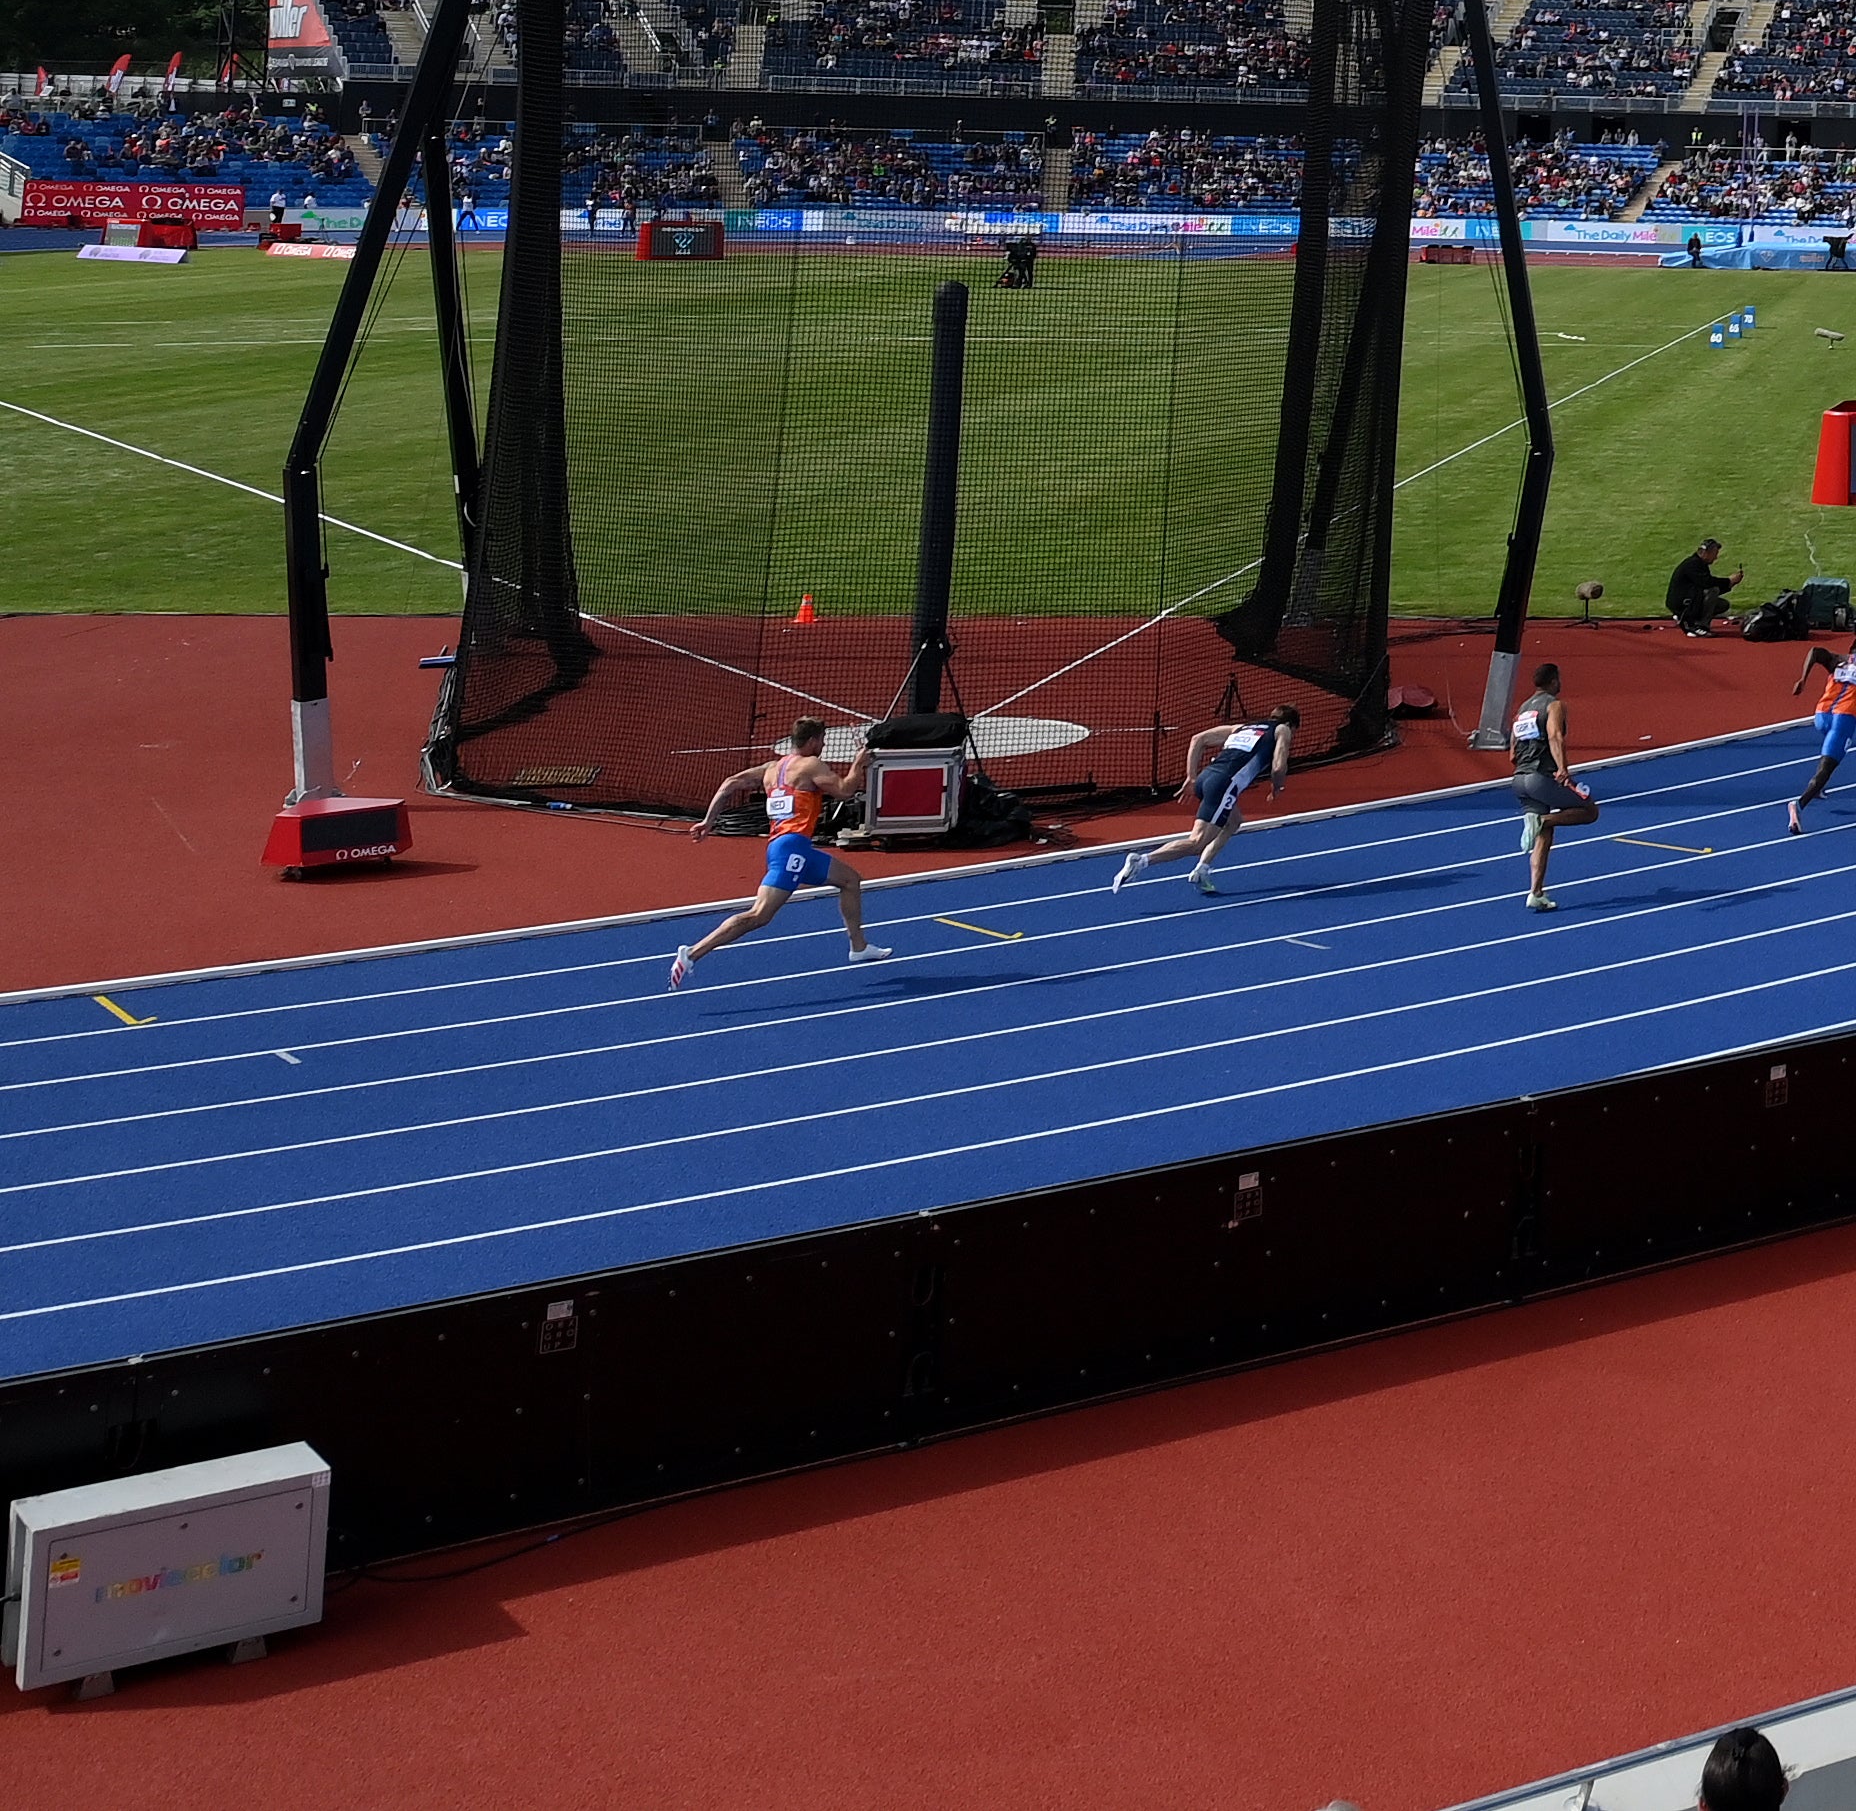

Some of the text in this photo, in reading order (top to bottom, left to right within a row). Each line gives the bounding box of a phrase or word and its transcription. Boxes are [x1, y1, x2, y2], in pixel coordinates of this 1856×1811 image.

[52, 195, 125, 208] OMEGA
[167, 198, 240, 211] OMEGA
[1411, 226, 1439, 236] Mile
[1576, 230, 1657, 243] The Daily Mile
[791, 856, 800, 870] 3
